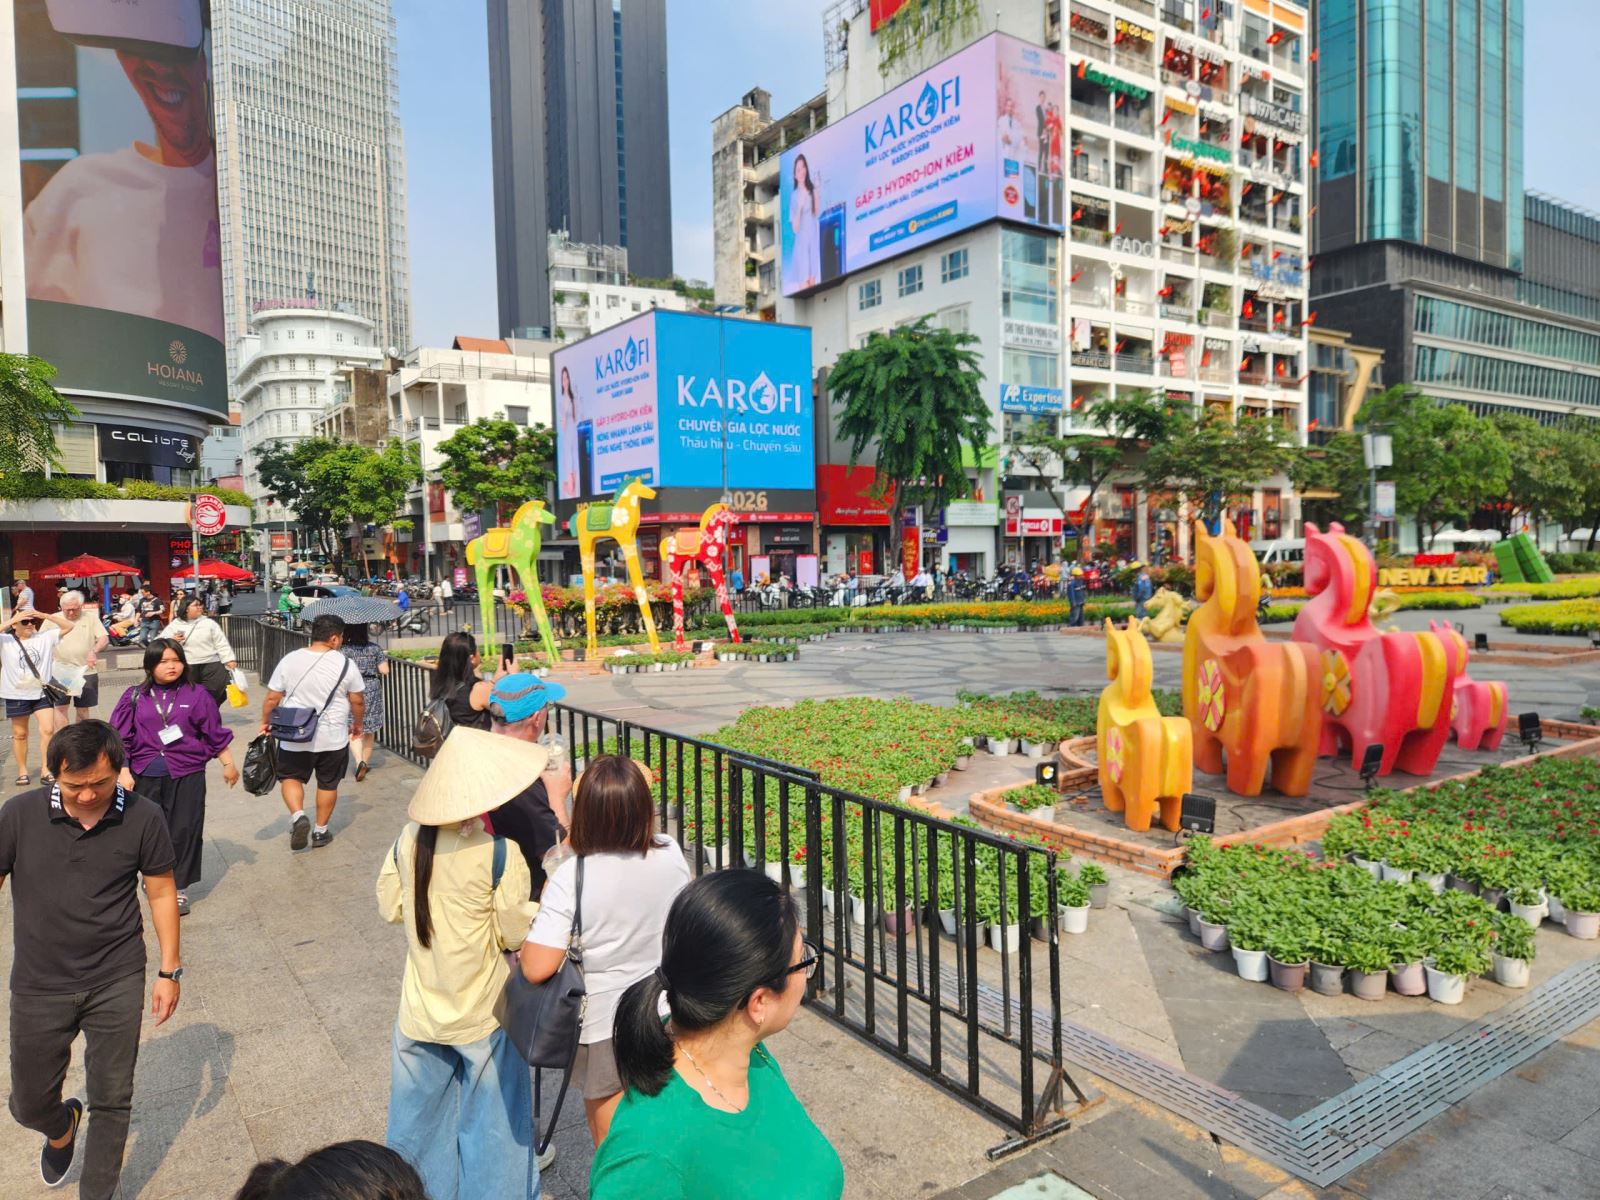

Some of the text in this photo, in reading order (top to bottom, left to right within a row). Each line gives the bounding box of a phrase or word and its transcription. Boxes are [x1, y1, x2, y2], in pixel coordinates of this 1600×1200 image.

[864, 76, 961, 154] KAROFI
[877, 186, 883, 199] 3
[884, 158, 943, 195] HYDRO-ION
[1114, 235, 1154, 258] FADO
[594, 336, 649, 382] KAROFI
[147, 361, 205, 386] HOIANA
[677, 371, 801, 414] KAROFI
[1023, 390, 1063, 405] Expertise
[727, 421, 747, 435] GIA
[750, 423, 770, 438] LỌC
[711, 436, 734, 450] hiu
[1378, 567, 1487, 585] NEW YEAR
